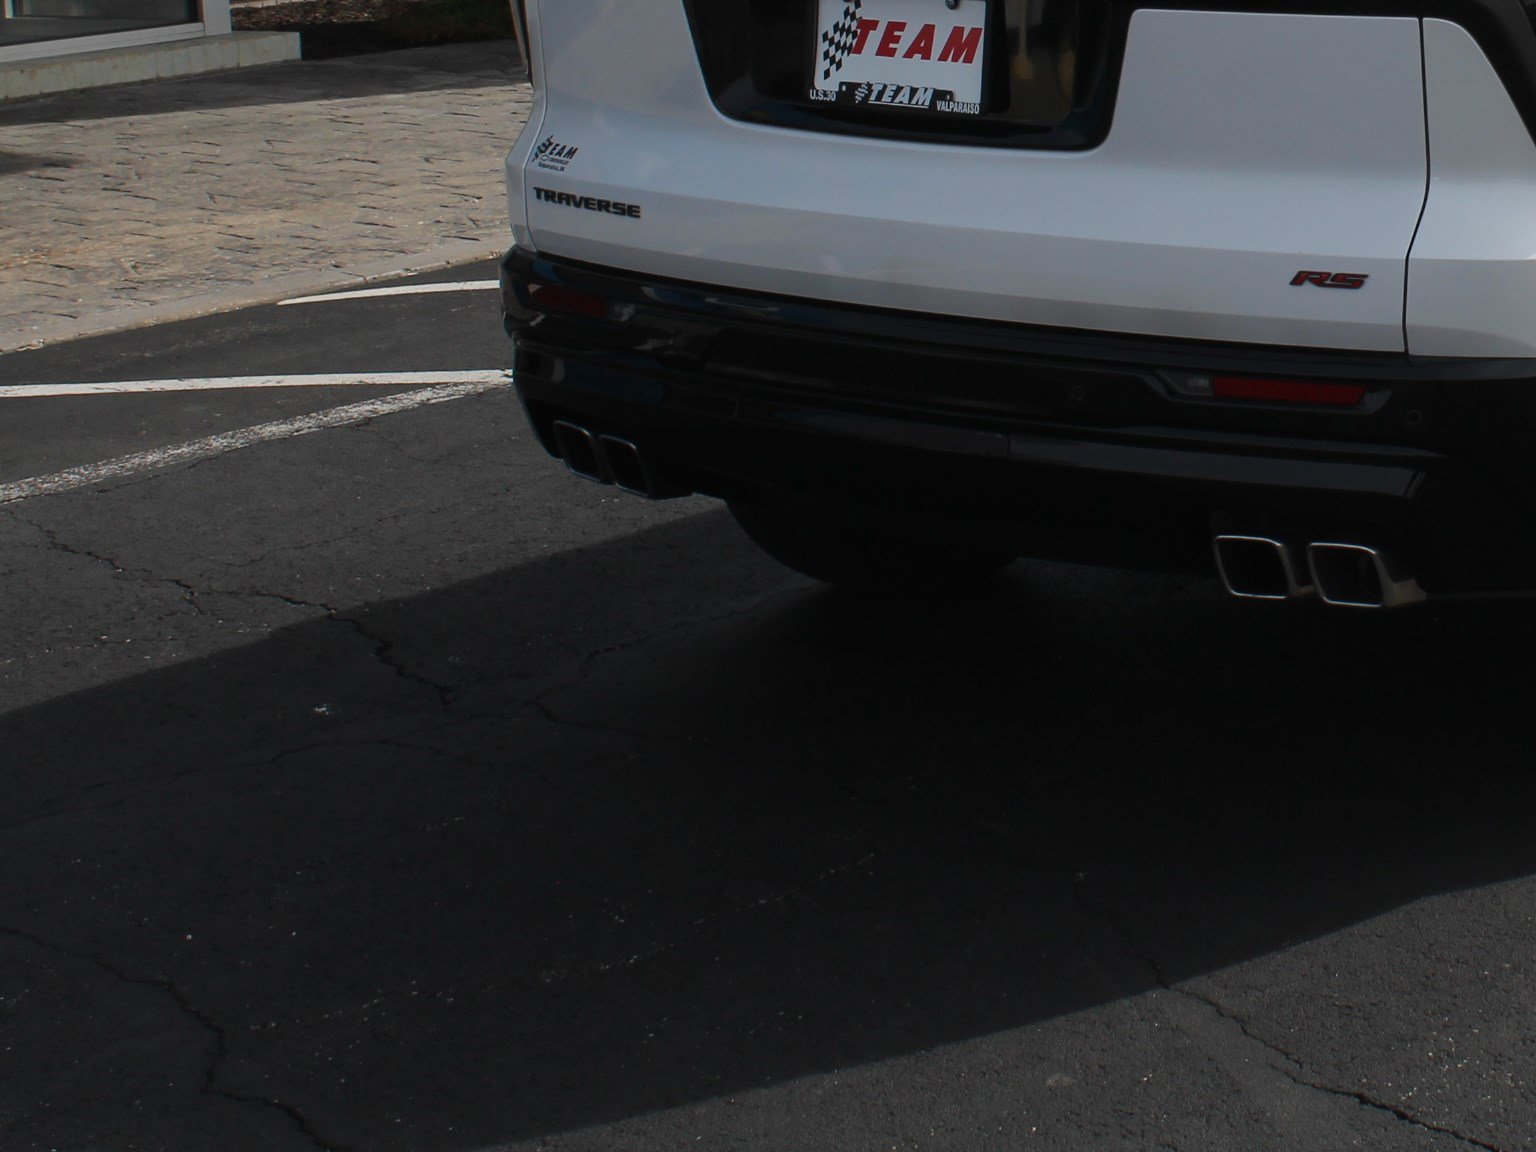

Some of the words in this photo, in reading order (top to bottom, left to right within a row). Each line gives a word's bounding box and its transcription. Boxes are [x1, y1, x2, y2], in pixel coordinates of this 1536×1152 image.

[851, 19, 983, 64] TEAM
[868, 82, 935, 106] TEAM
[936, 101, 980, 115] VALPARAISO
[533, 186, 641, 219] TRAVERSE
[1289, 270, 1369, 289] RS
